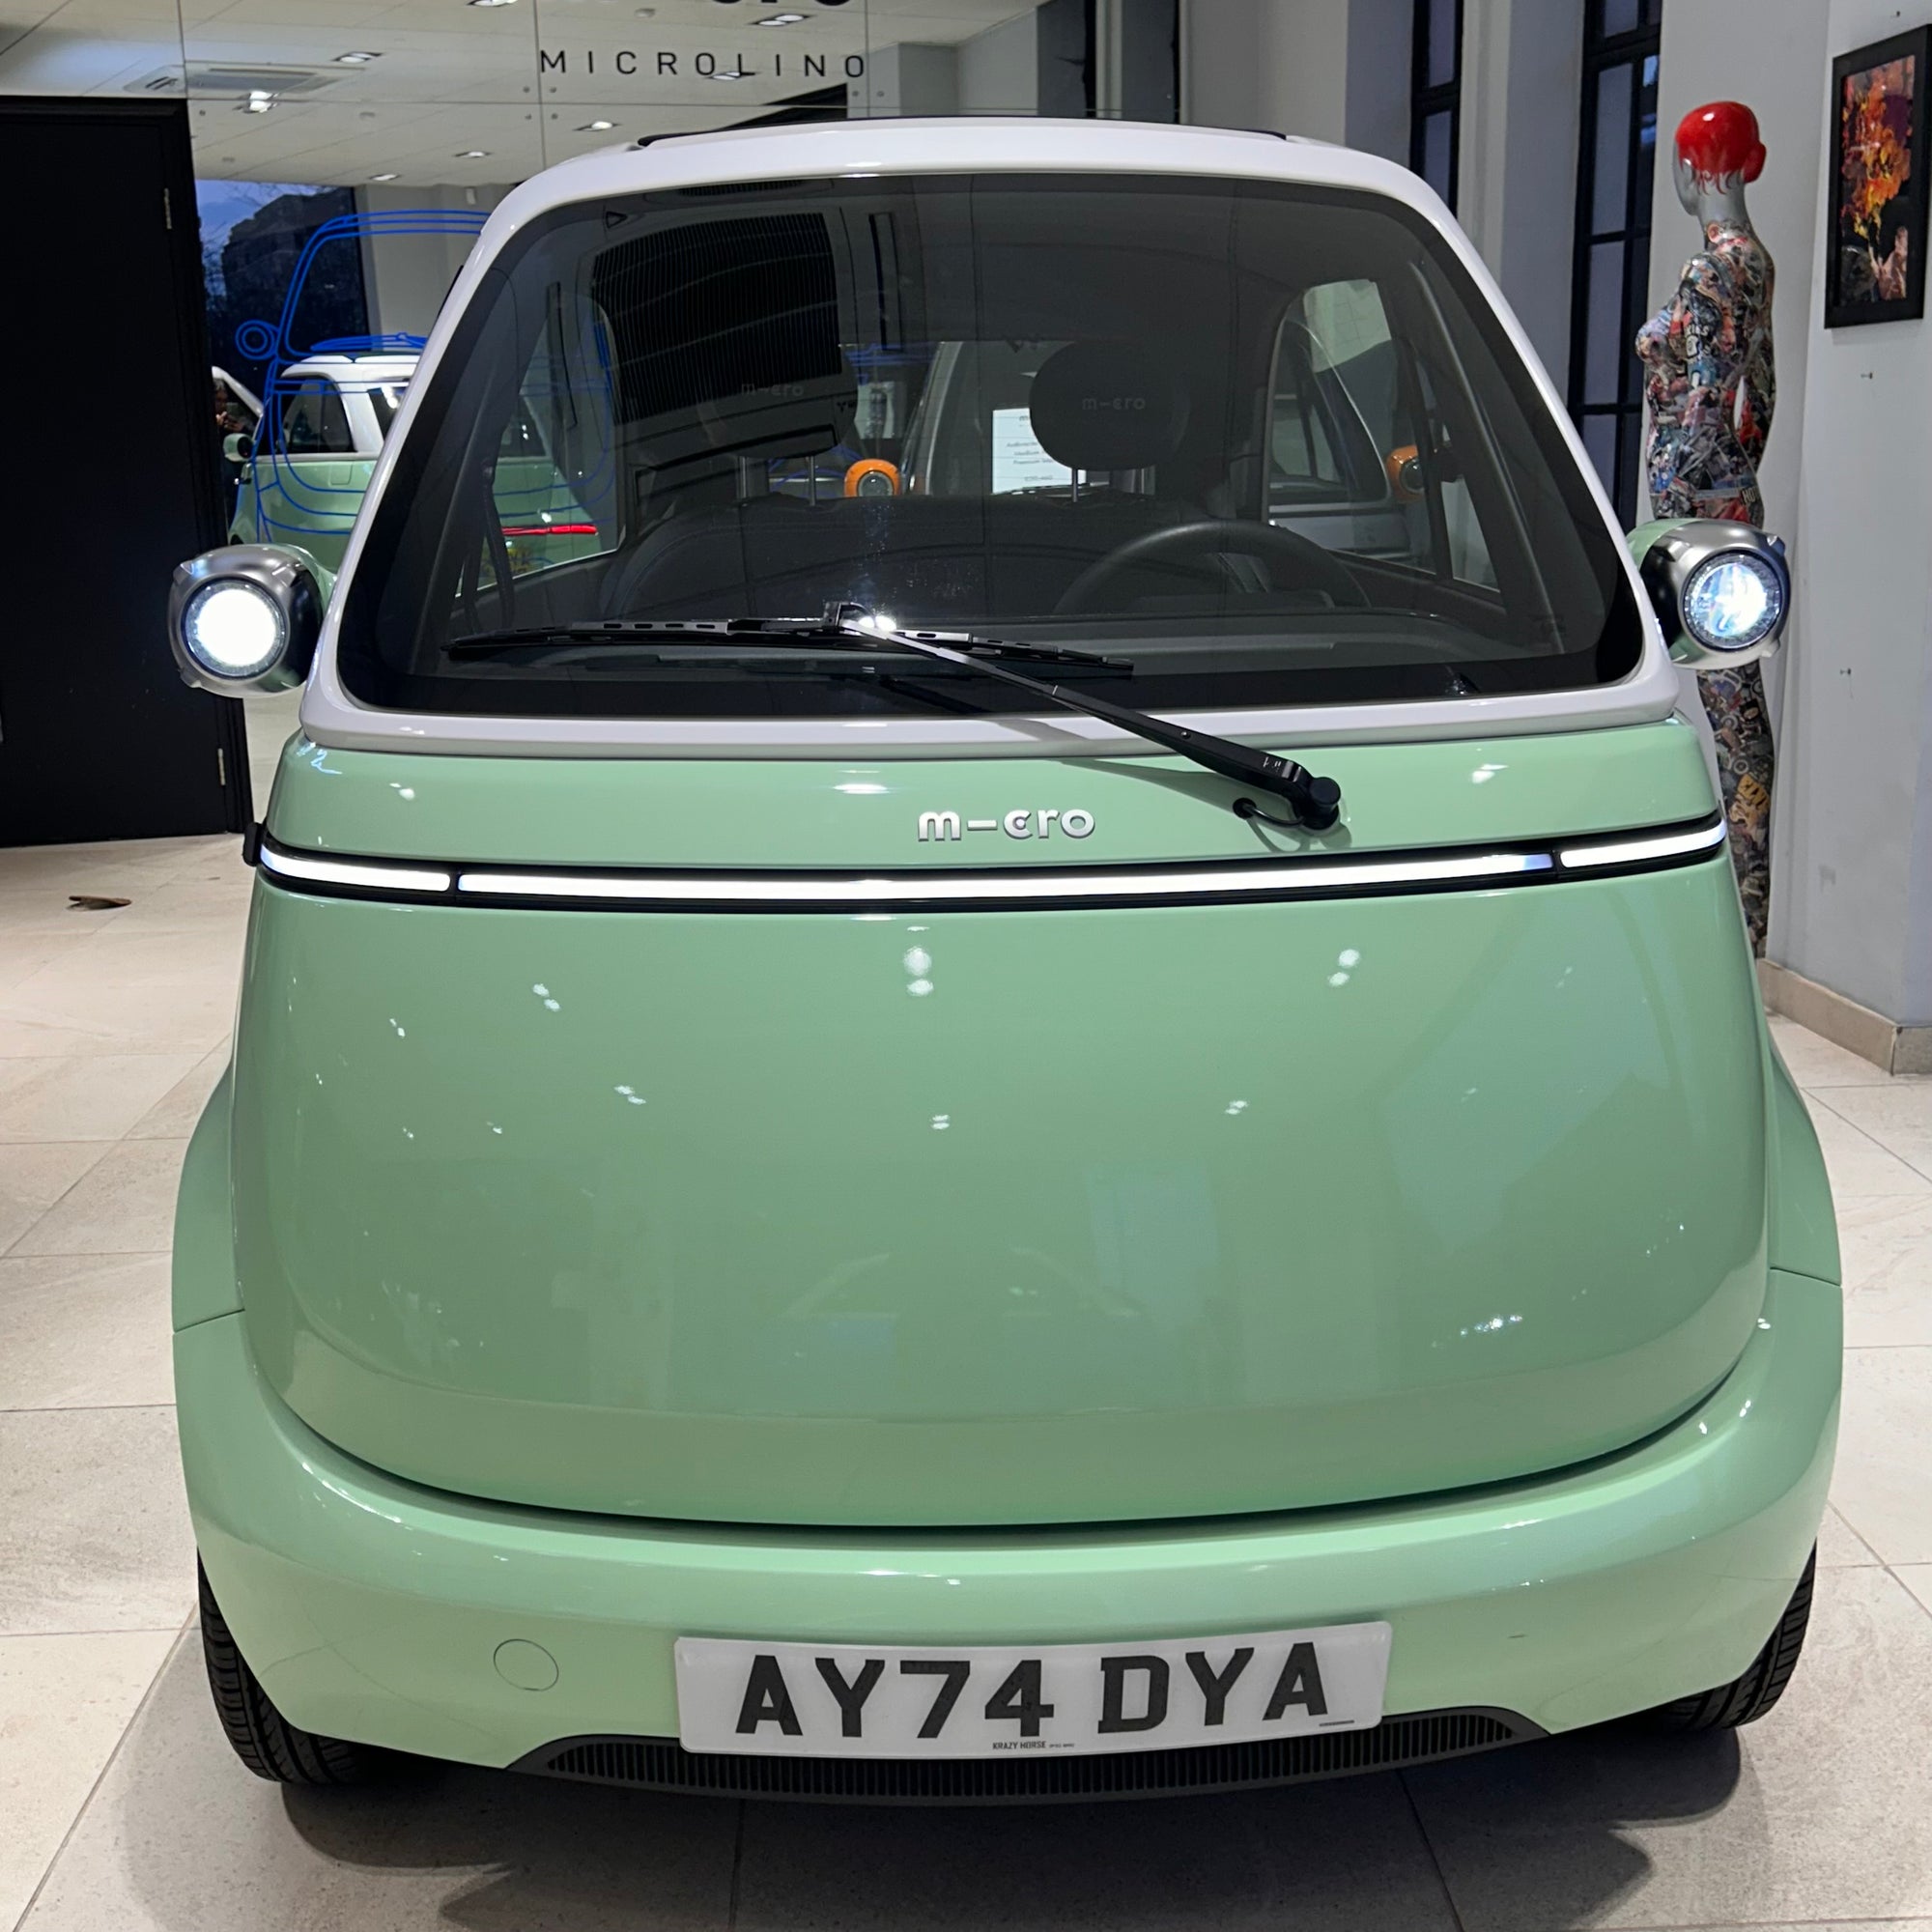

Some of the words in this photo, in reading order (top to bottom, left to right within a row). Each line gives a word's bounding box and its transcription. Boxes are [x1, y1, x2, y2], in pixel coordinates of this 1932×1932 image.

[540, 50, 865, 78] MICROLINO
[735, 1655, 1055, 1739] AY74
[1097, 1641, 1328, 1734] DYA
